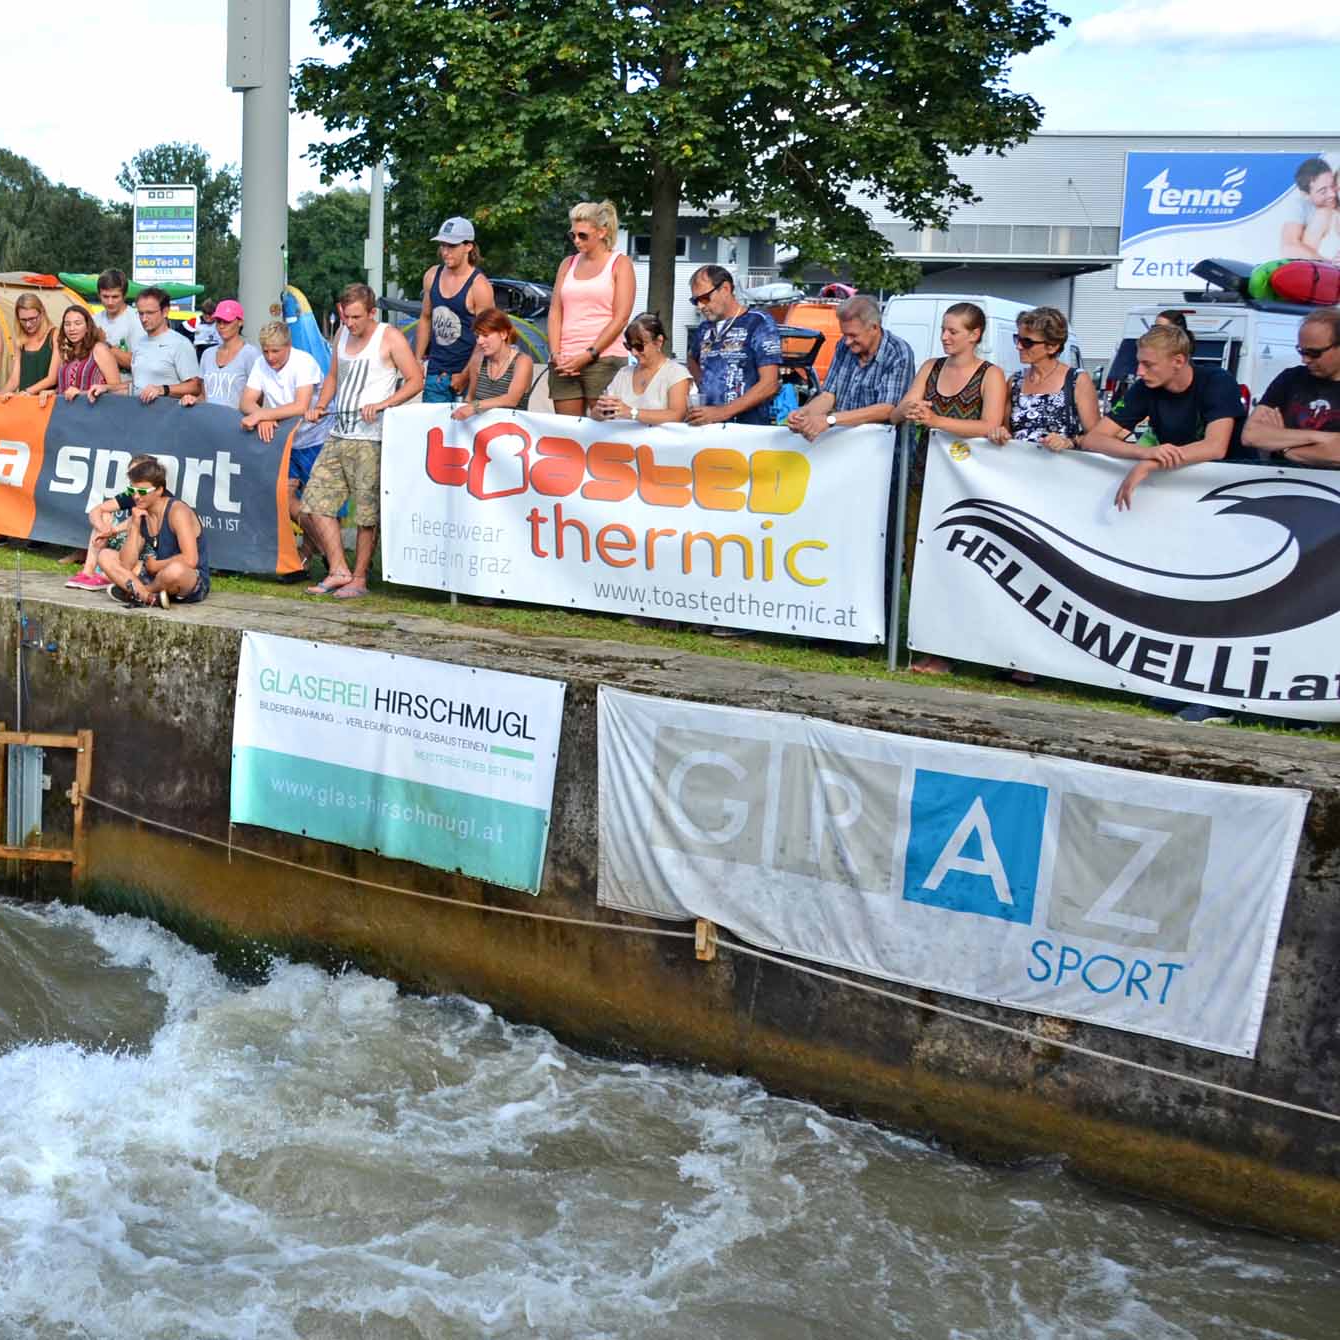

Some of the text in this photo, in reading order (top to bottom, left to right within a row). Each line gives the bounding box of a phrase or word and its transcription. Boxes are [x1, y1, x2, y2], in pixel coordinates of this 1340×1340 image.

[225, 519, 241, 532] IST
[410, 512, 506, 543] fleecewear
[526, 502, 829, 587] thermic
[403, 544, 512, 577] made in graz
[594, 581, 859, 628] www.toastedthermic.at
[259, 667, 537, 741] GLASEREI HIRSCHMUGL
[345, 716, 392, 734] VERLEGUNG
[393, 725, 412, 738] VON
[412, 728, 488, 753] GLASBAUSTEINEN
[268, 776, 505, 844] www.glas-hirschmugl.at
[666, 749, 1174, 935] GRAZ
[1026, 939, 1186, 1005] SPORT
